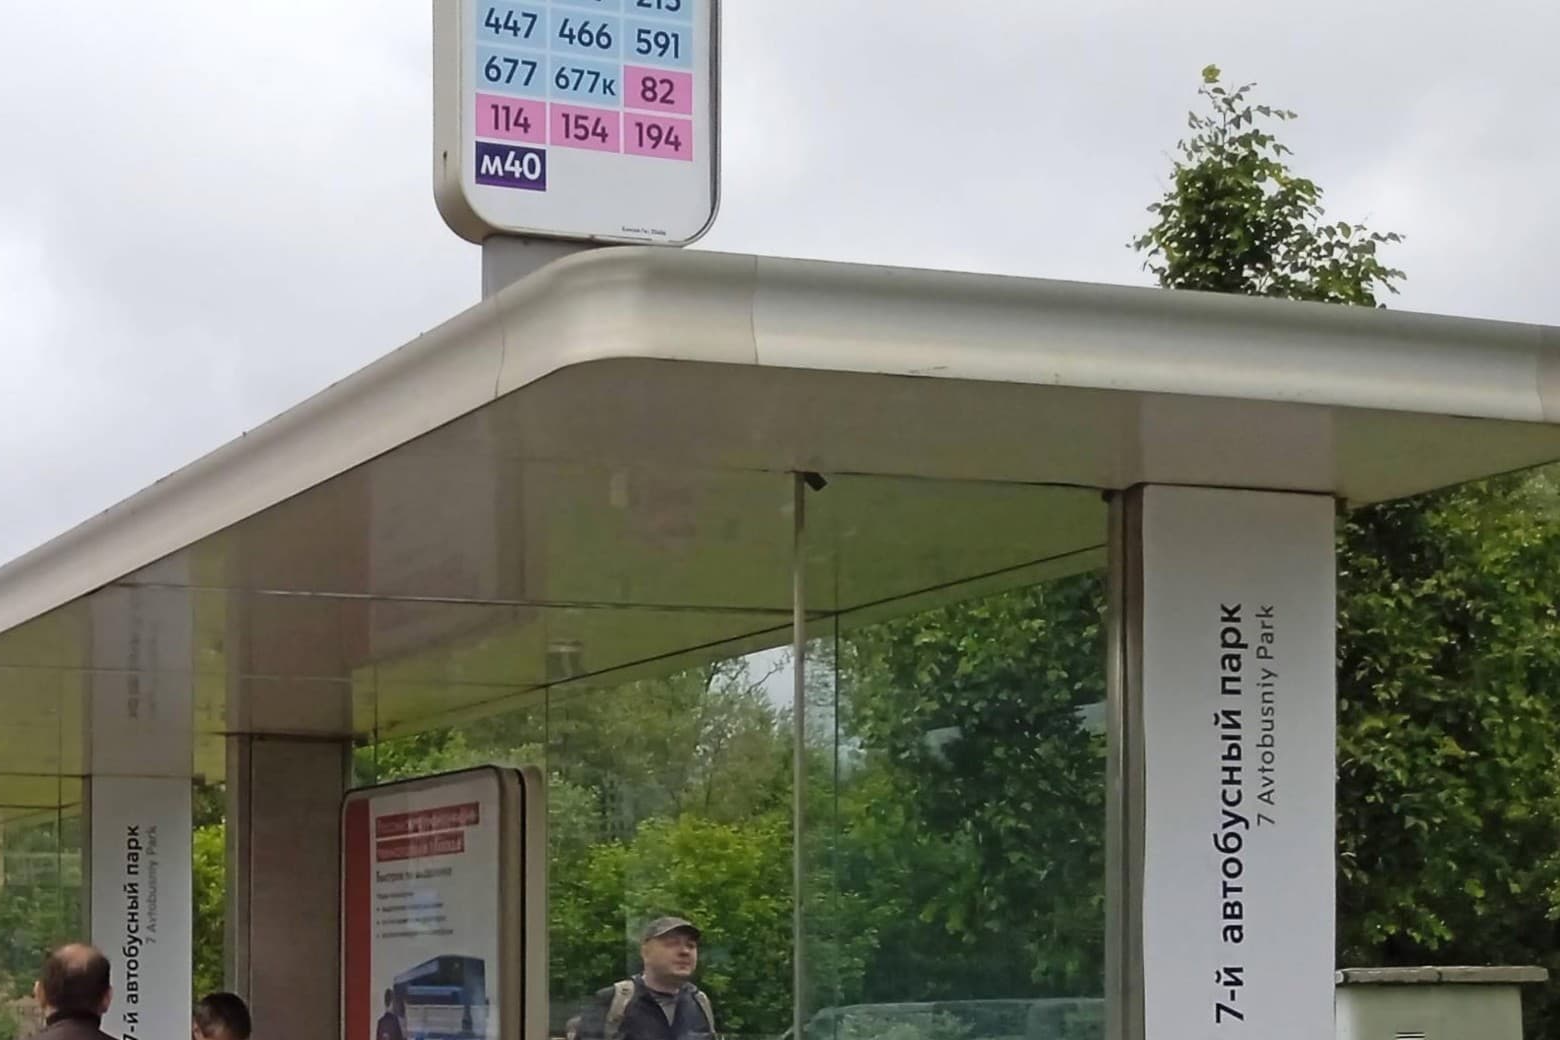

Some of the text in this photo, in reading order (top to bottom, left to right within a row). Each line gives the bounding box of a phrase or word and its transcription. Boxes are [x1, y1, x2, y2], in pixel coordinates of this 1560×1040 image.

[484, 7, 680, 59] 447 466 591
[484, 55, 538, 87] 677
[640, 76, 675, 105] 82
[490, 104, 682, 152] 114 154 194
[1255, 605, 1279, 827] 7 Avtobusniy Park
[1213, 603, 1250, 1024] 7-й автобусный парк
[127, 825, 143, 876] парк
[123, 882, 143, 1005] автобусный
